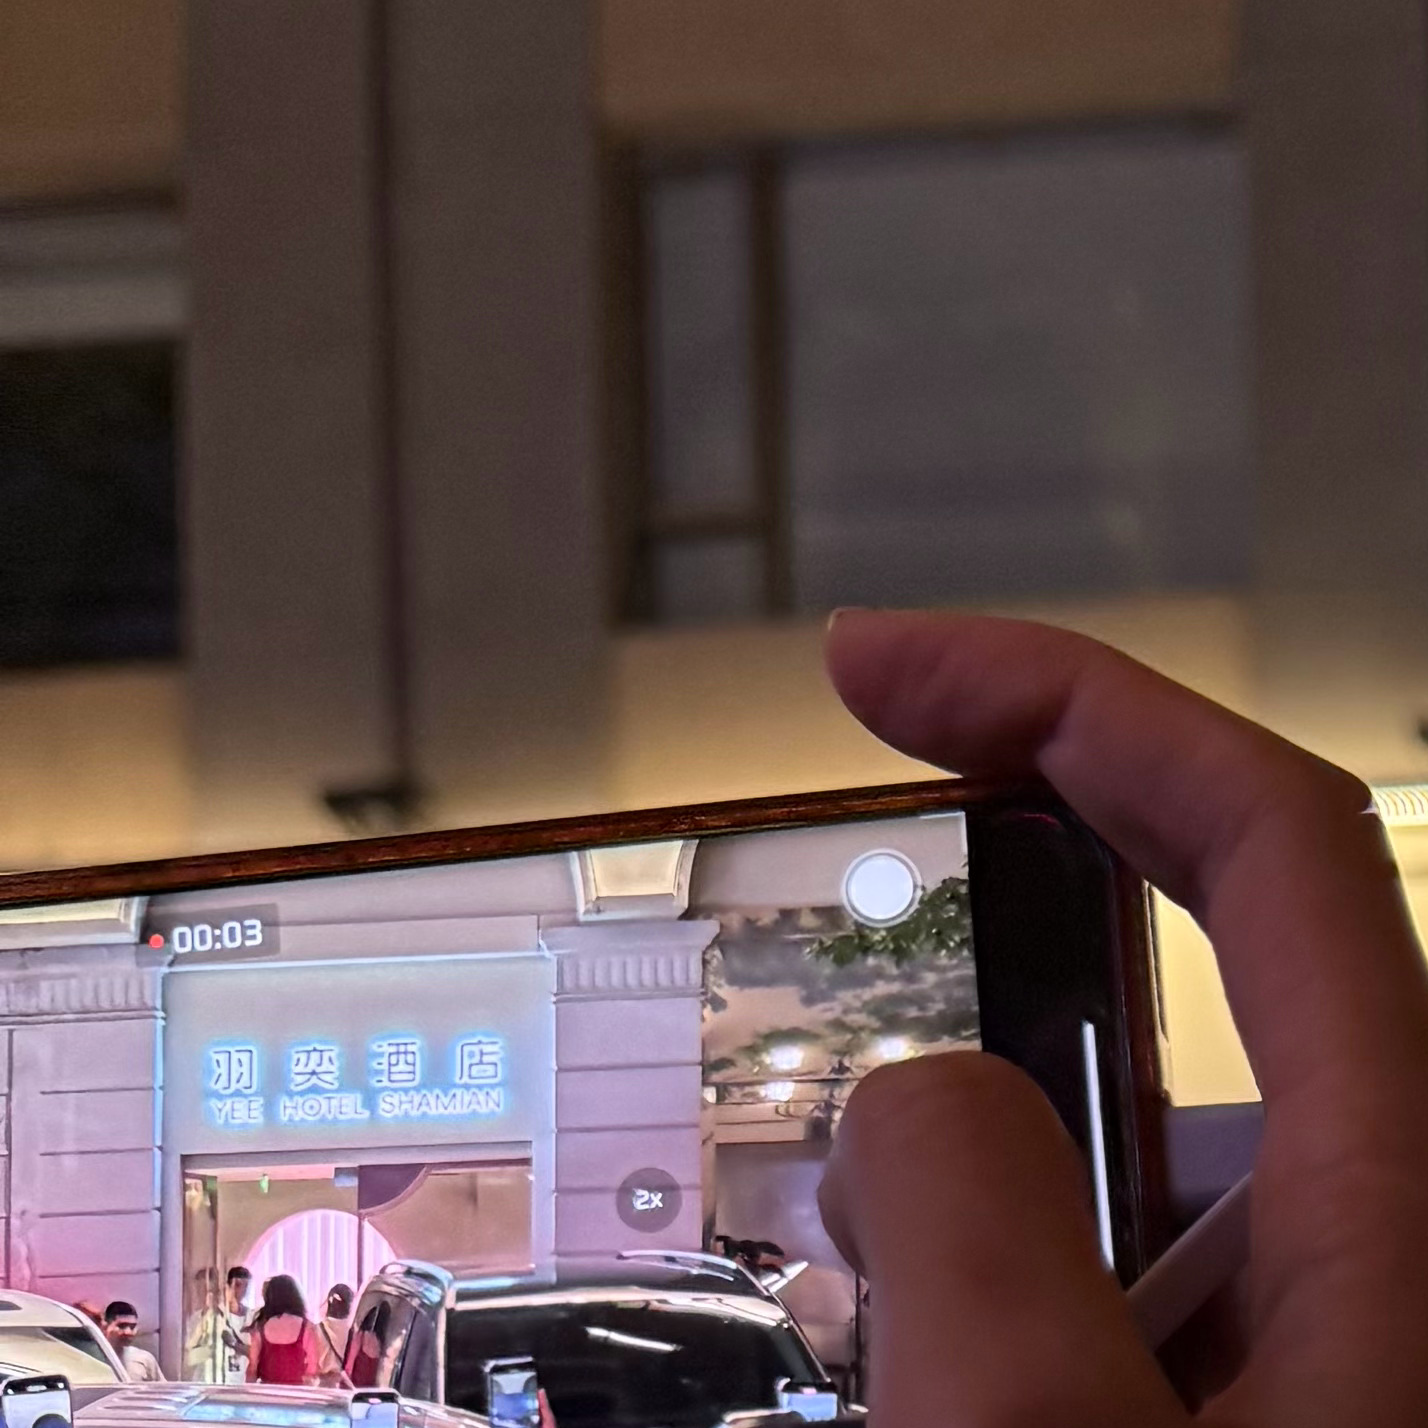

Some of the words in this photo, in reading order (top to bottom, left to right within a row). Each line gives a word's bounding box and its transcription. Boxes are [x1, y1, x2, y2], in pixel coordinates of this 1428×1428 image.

[173, 918, 263, 953] 00:03
[211, 1039, 502, 1091] 羽奕酒店
[211, 1098, 263, 1122] YEE
[280, 1093, 367, 1120] HOTEL
[379, 1089, 502, 1116] SHAMIAN
